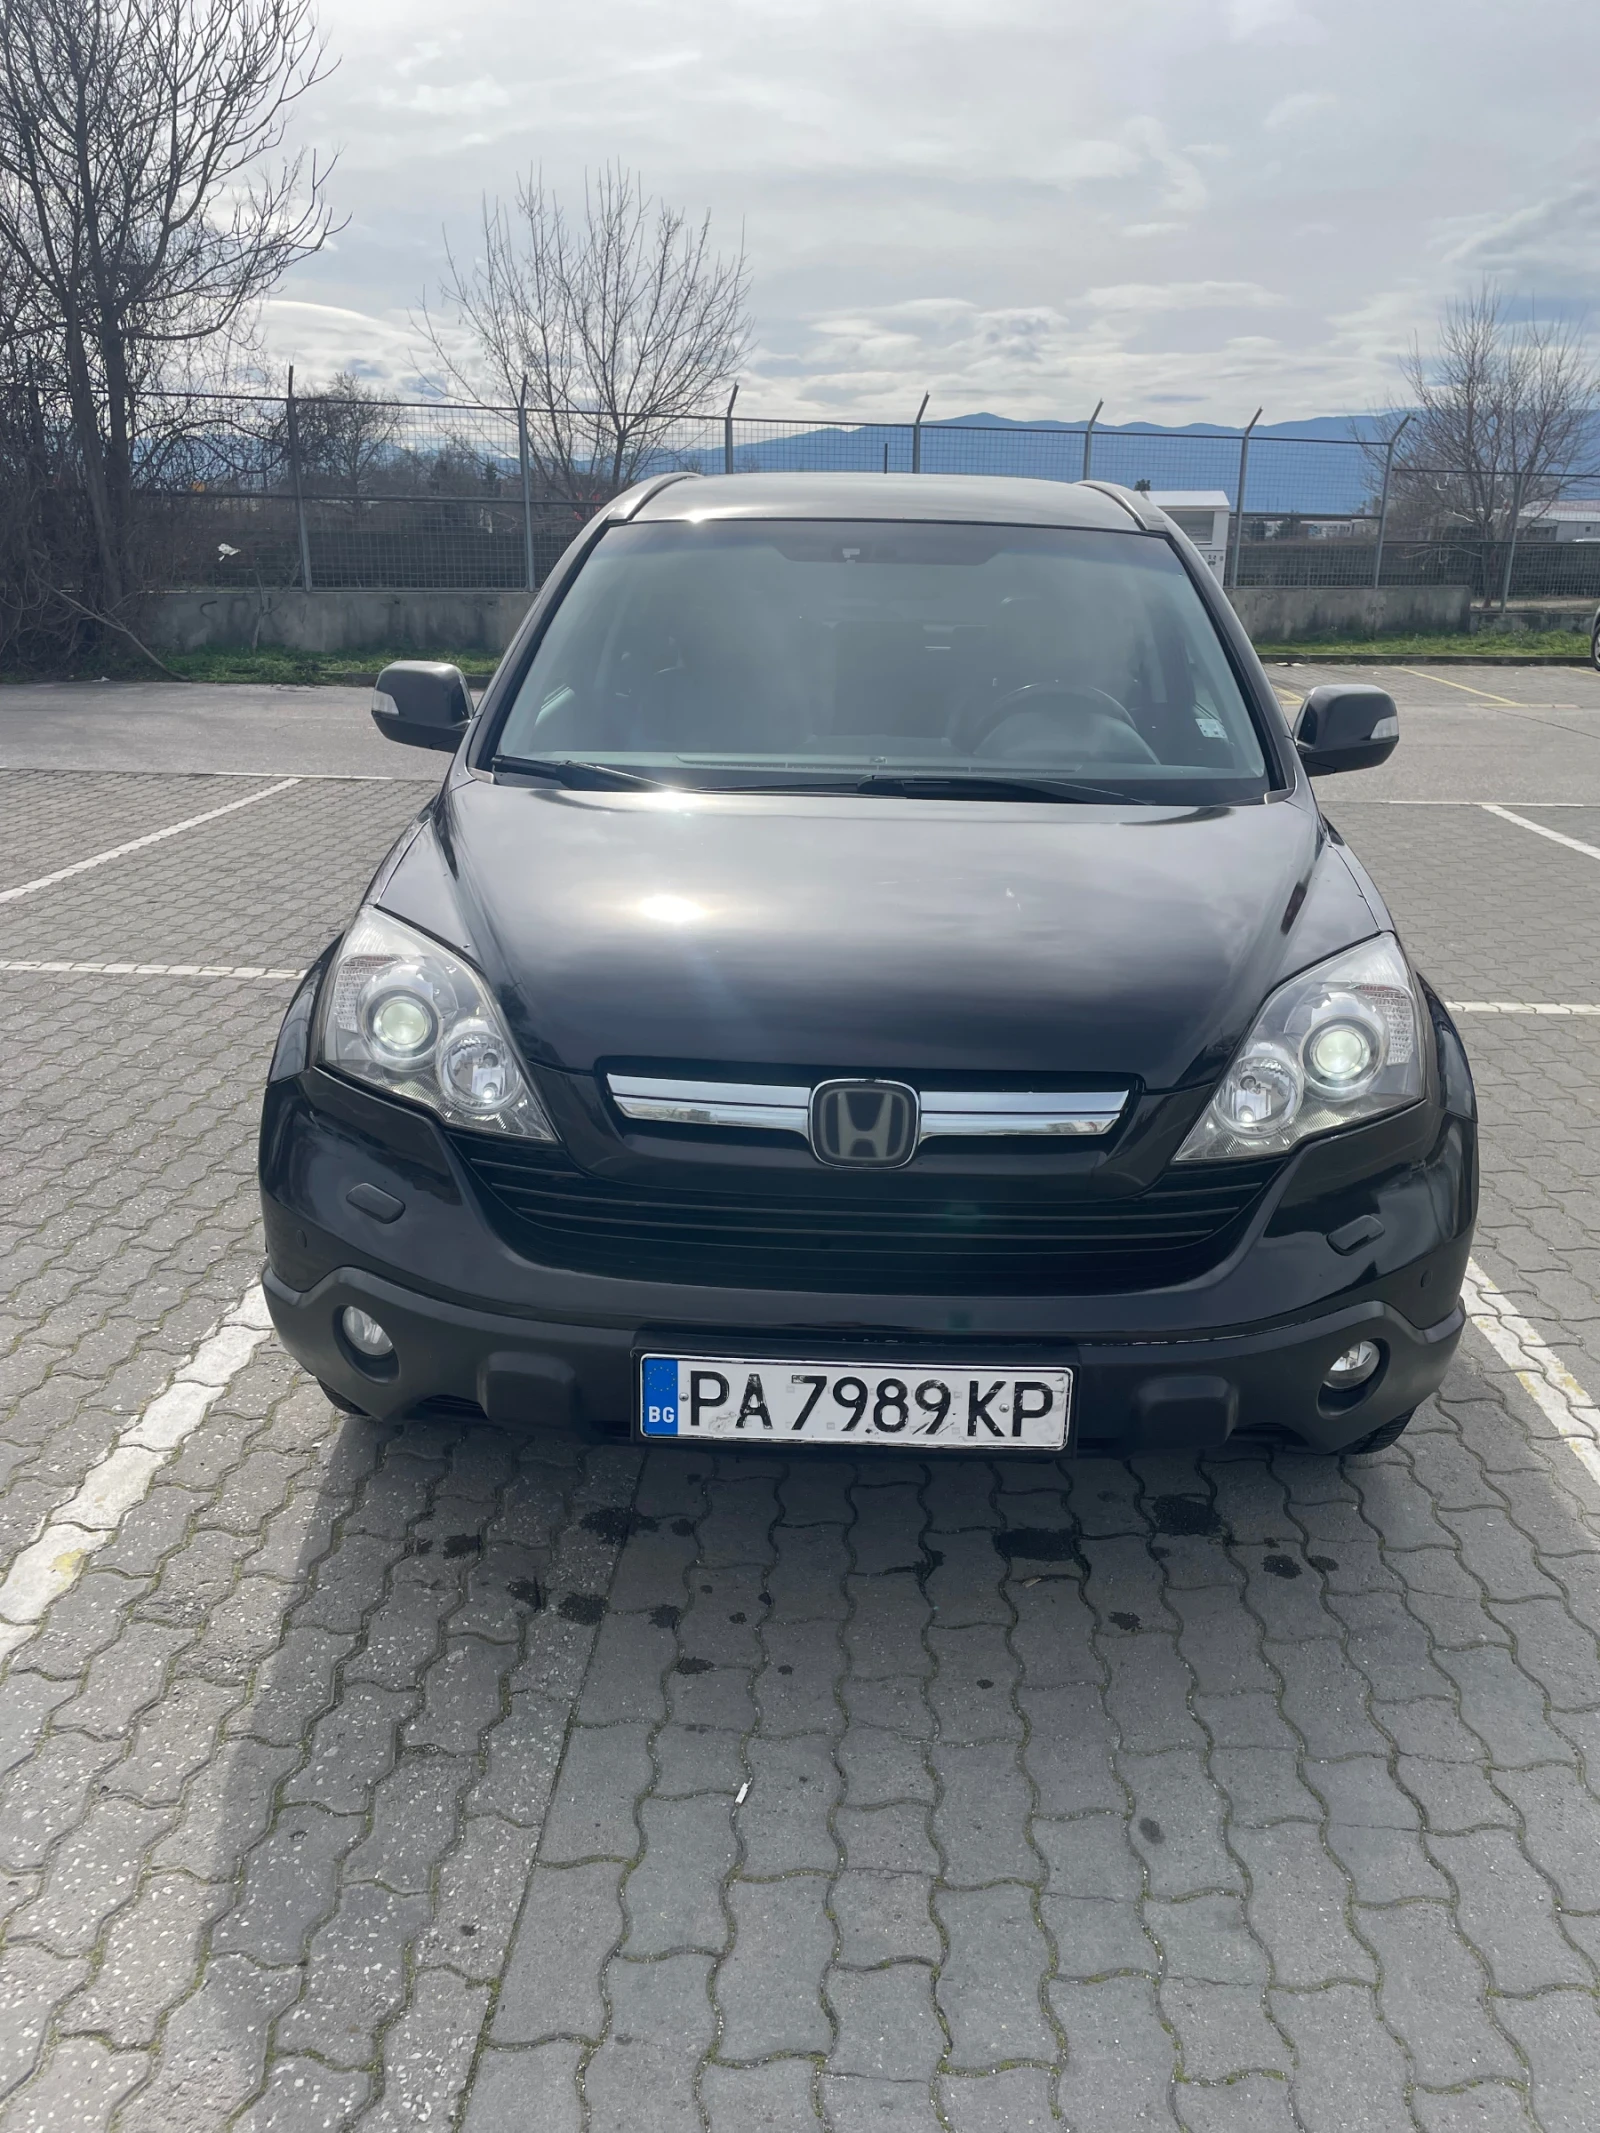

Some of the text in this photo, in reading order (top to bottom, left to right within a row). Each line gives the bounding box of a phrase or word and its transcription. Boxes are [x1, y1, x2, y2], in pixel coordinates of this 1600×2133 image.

[648, 1405, 675, 1423] BG
[690, 1370, 1054, 1437] PA 7989 KP
